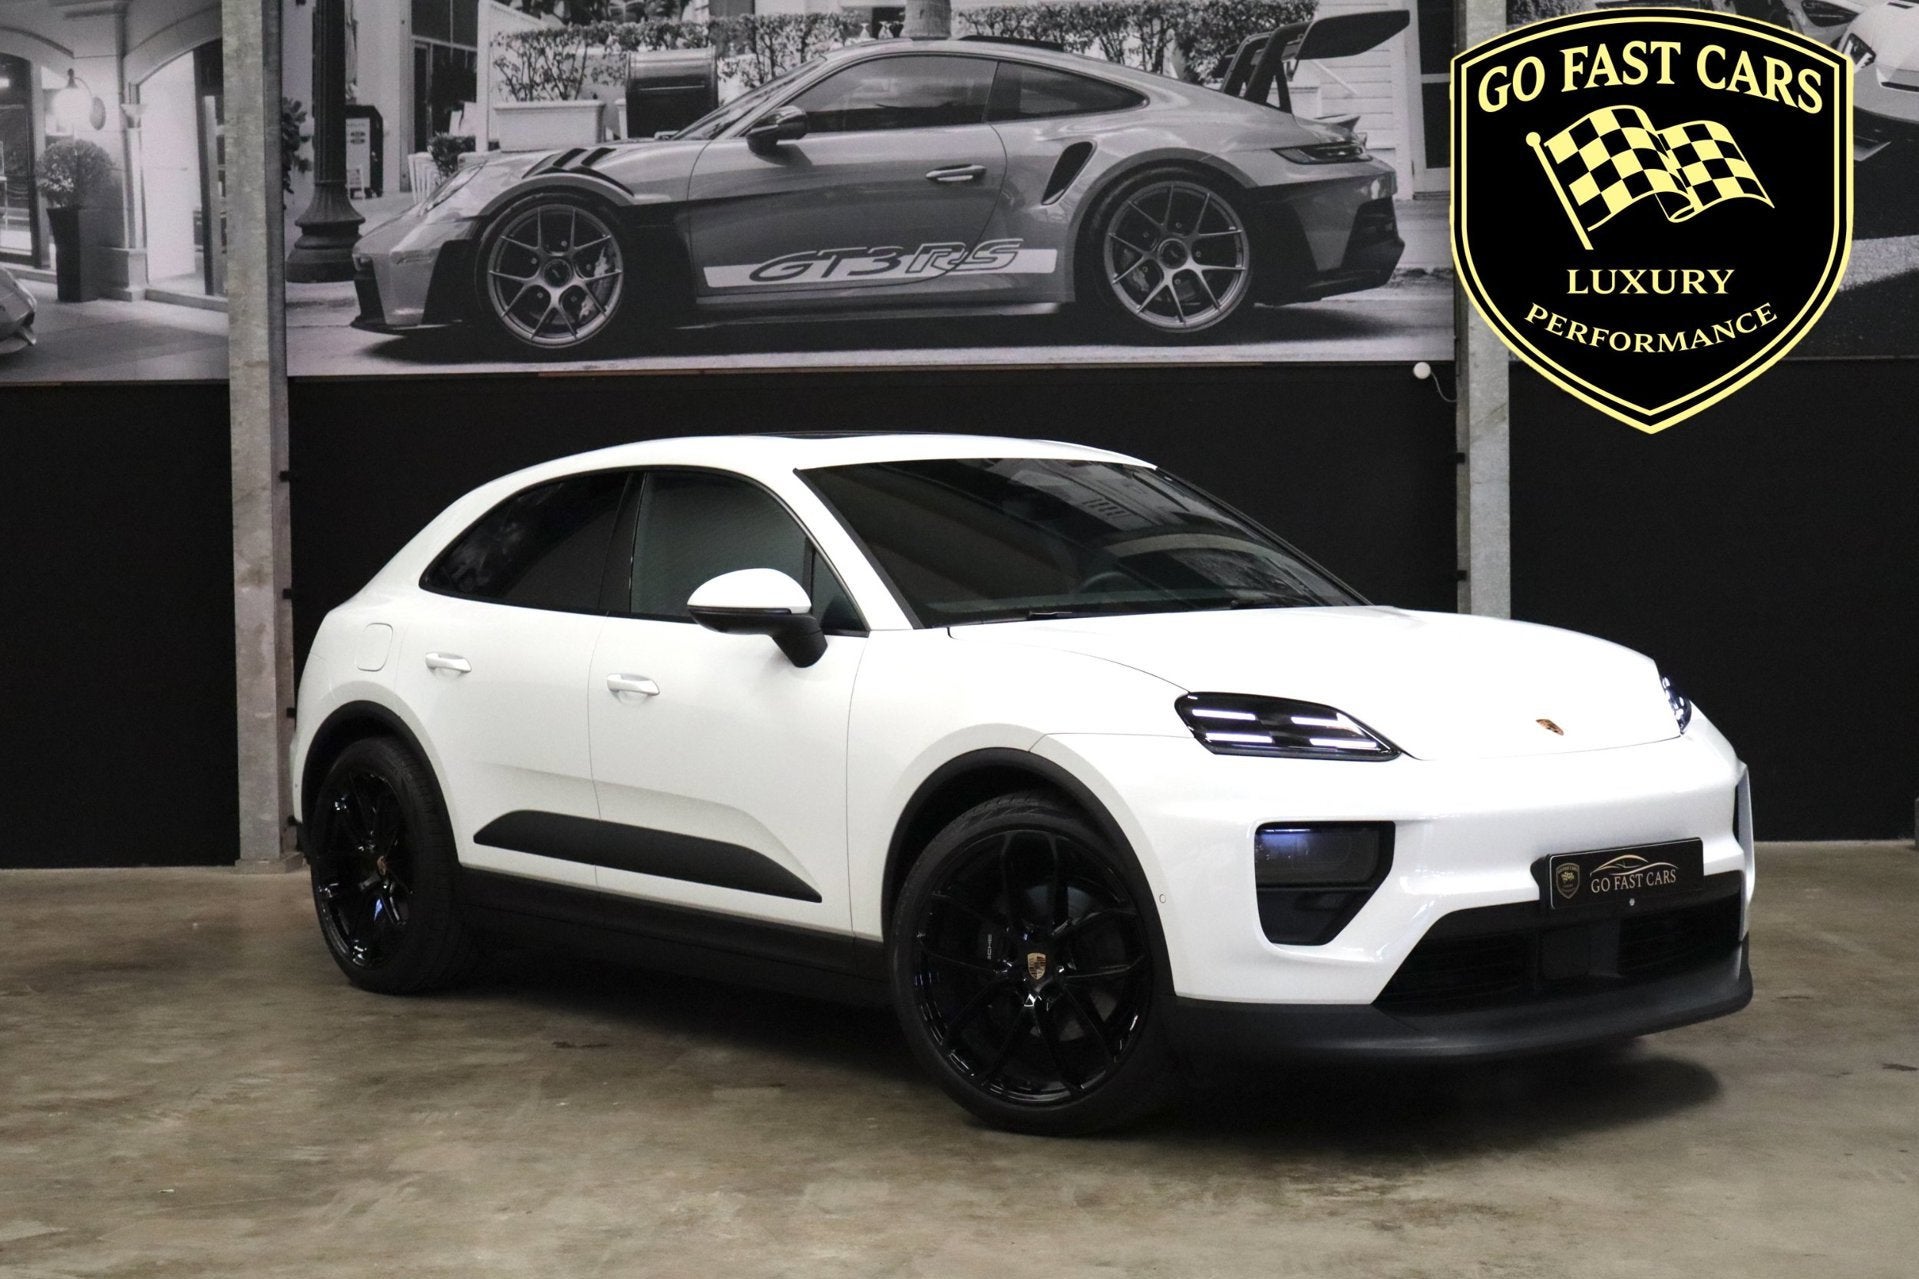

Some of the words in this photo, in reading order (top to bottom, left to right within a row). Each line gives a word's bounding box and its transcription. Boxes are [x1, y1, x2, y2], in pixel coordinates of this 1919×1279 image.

[1590, 878, 1611, 893] GO
[1614, 873, 1643, 890] FAST
[1646, 869, 1676, 886] CARS
